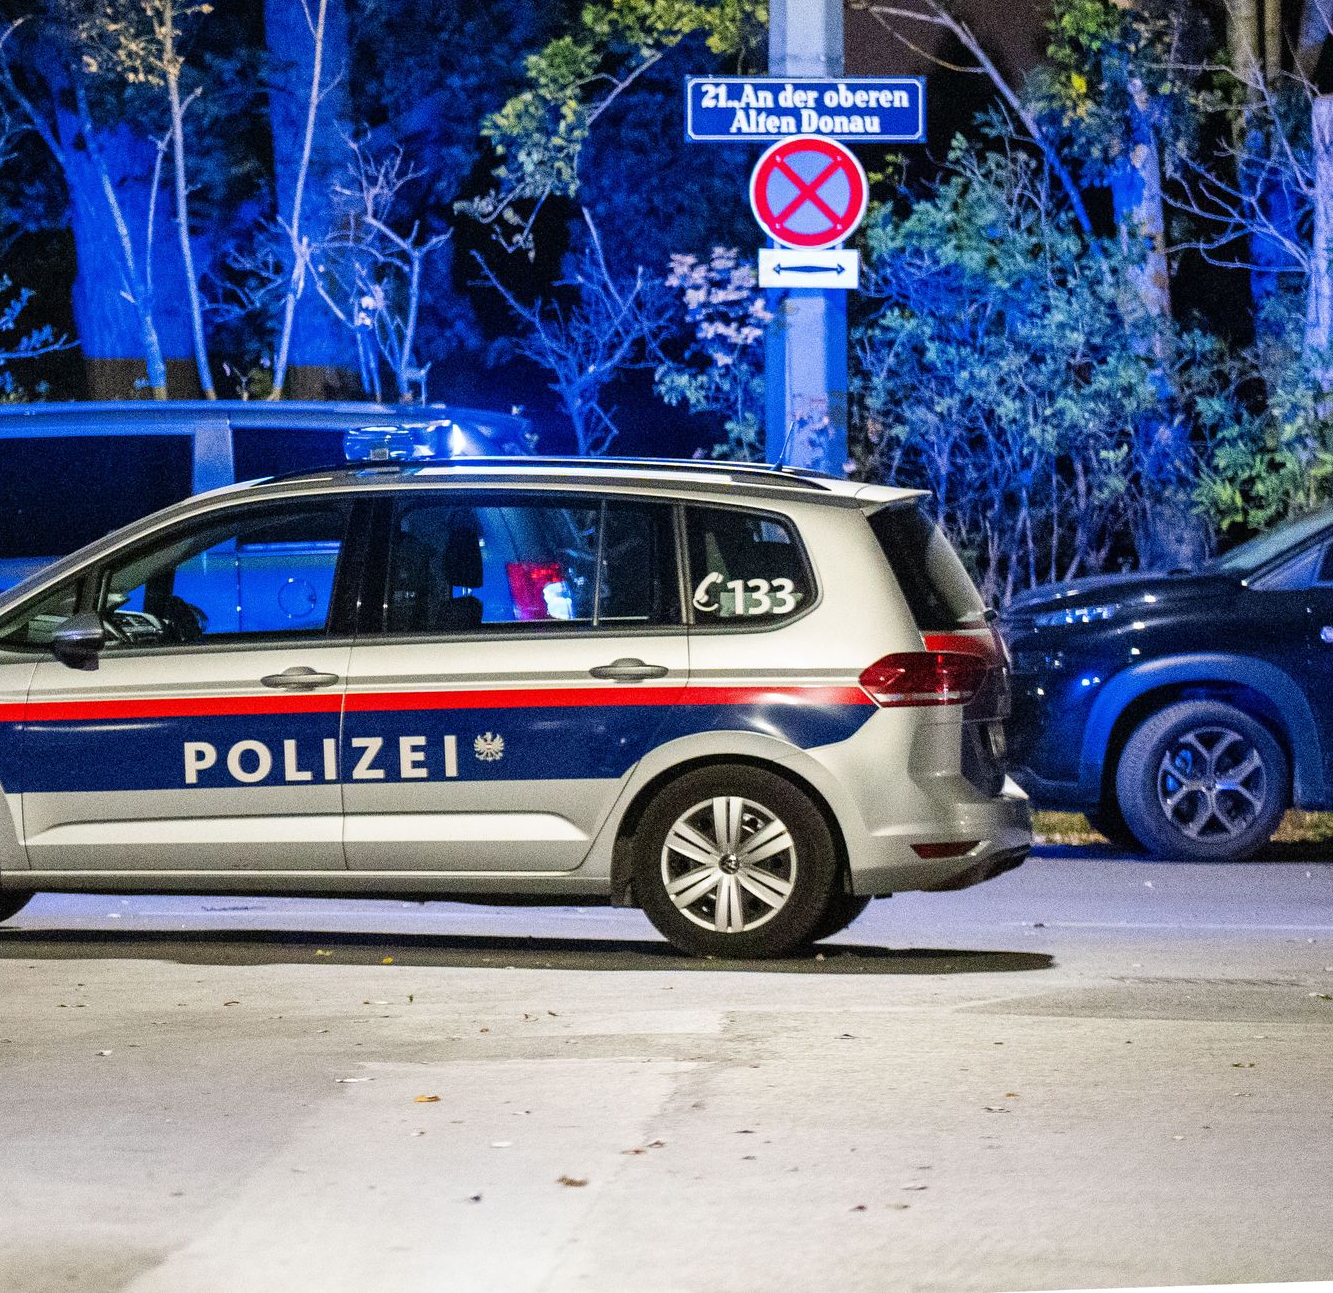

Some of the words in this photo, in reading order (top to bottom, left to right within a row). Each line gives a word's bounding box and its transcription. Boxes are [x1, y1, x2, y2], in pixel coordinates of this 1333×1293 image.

[778, 84, 819, 108] der
[824, 84, 910, 108] oberen
[729, 109, 797, 134] Alten
[801, 109, 881, 134] Donau
[726, 577, 797, 615] 133
[183, 734, 459, 784] POLIZEI
